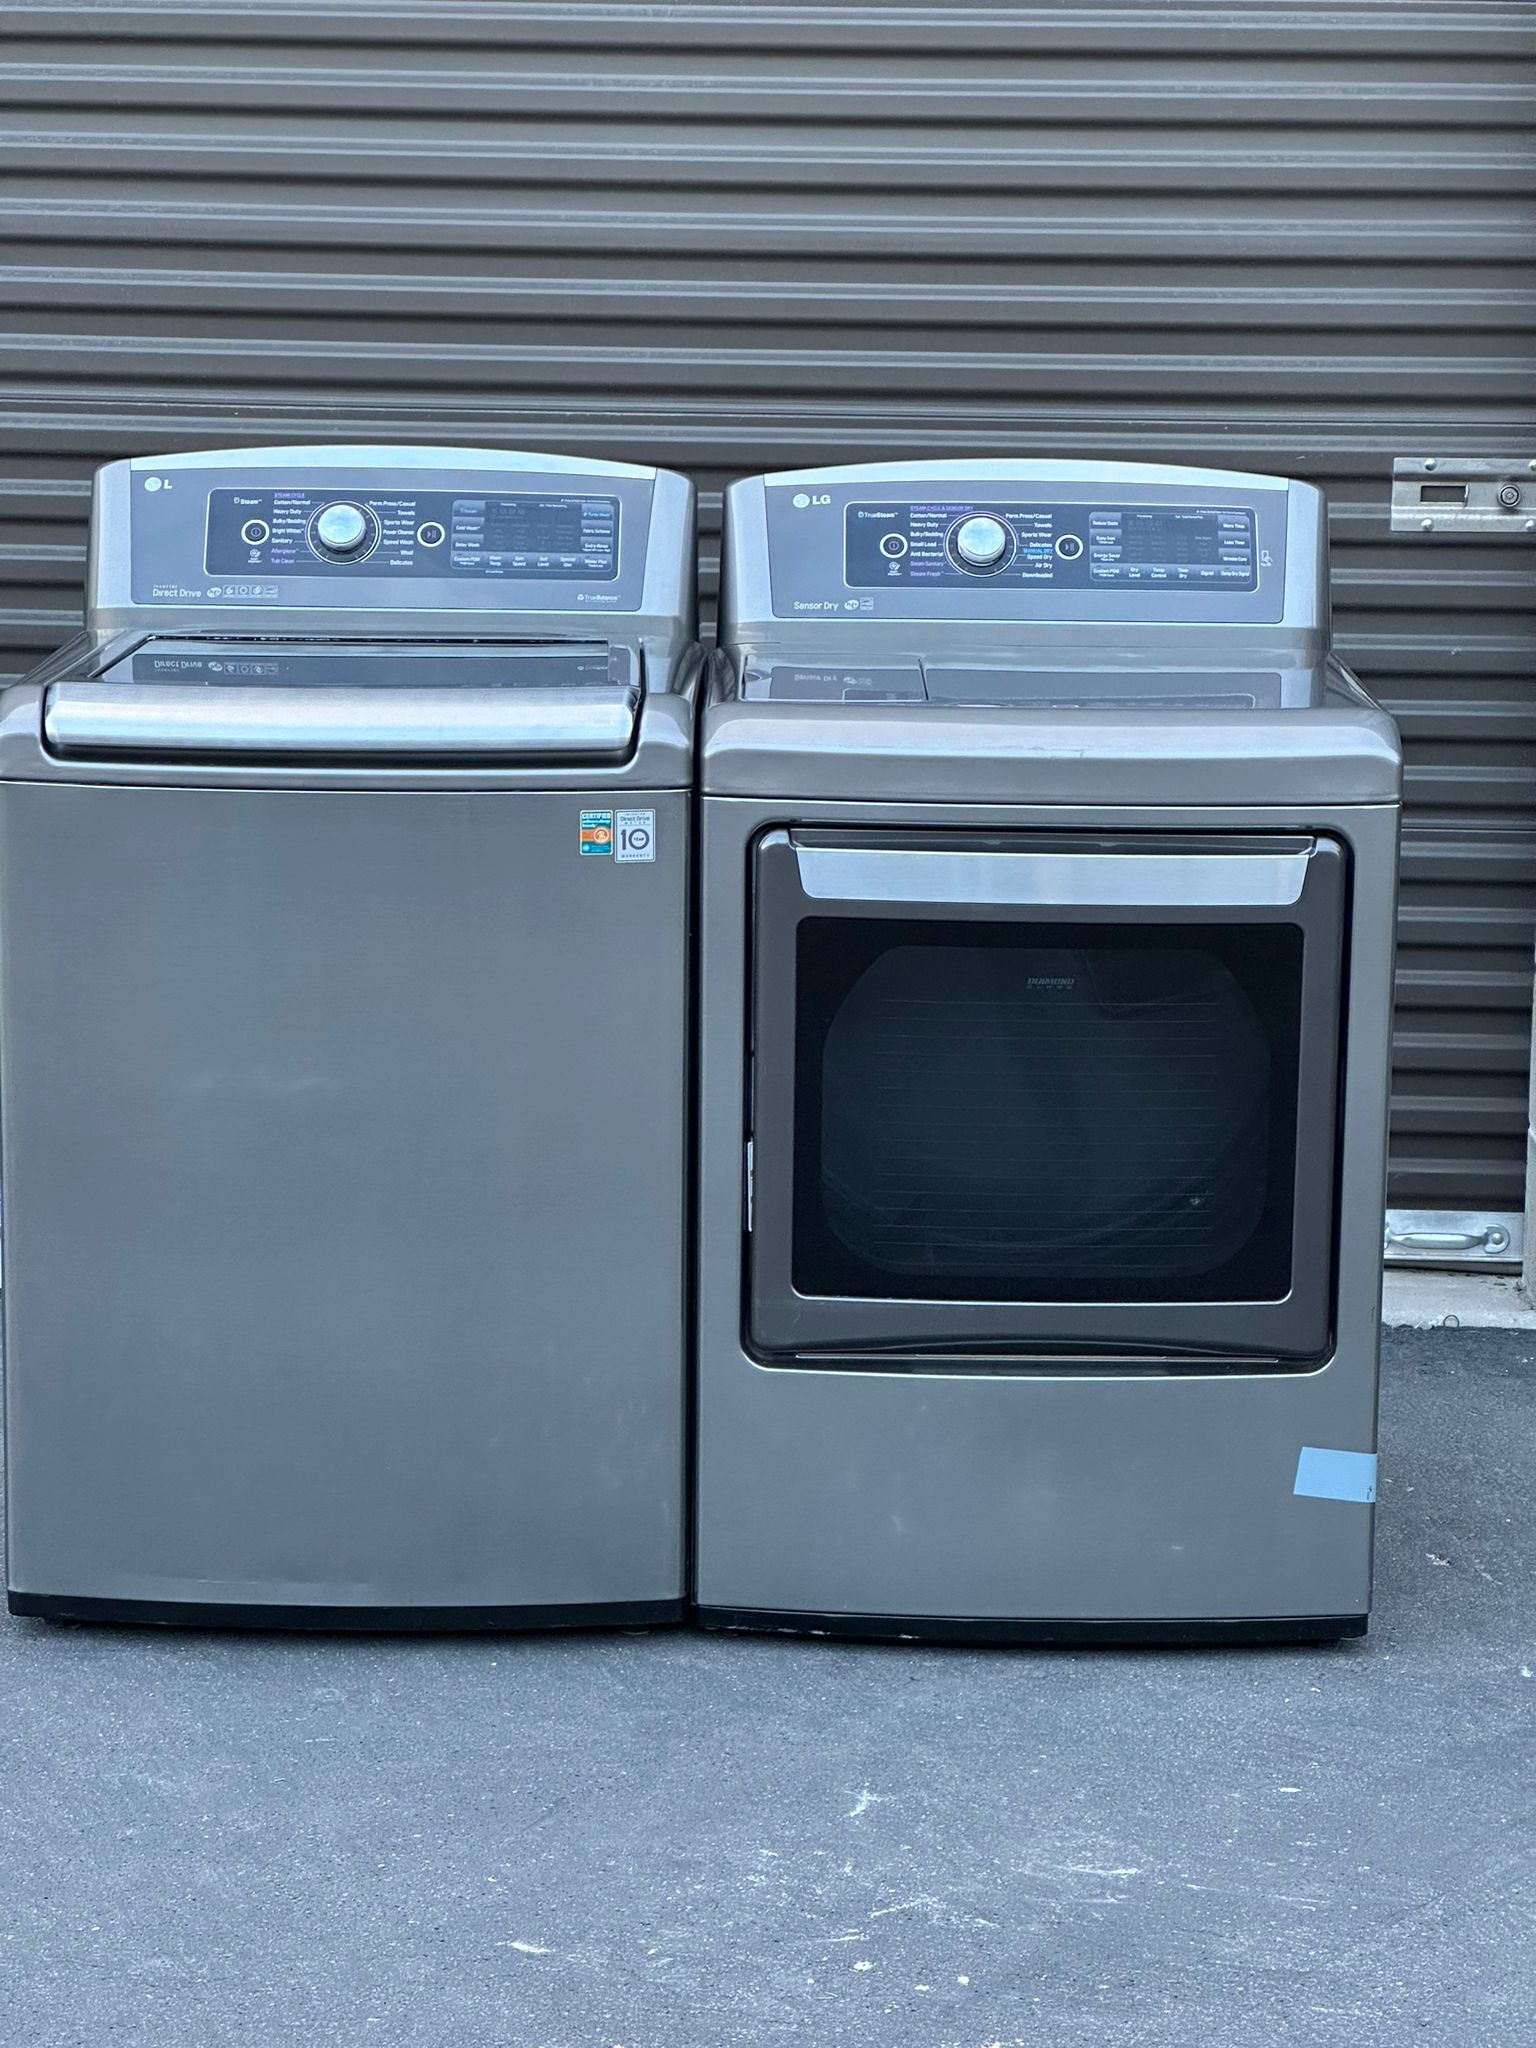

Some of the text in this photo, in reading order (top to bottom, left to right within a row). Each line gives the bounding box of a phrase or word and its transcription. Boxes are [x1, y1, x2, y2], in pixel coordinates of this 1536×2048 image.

[812, 494, 831, 505] LG
[152, 588, 179, 597] Direct
[179, 589, 202, 598] Drive
[793, 601, 823, 610] Sensor
[823, 602, 839, 612] Dry
[620, 828, 650, 850] 10
